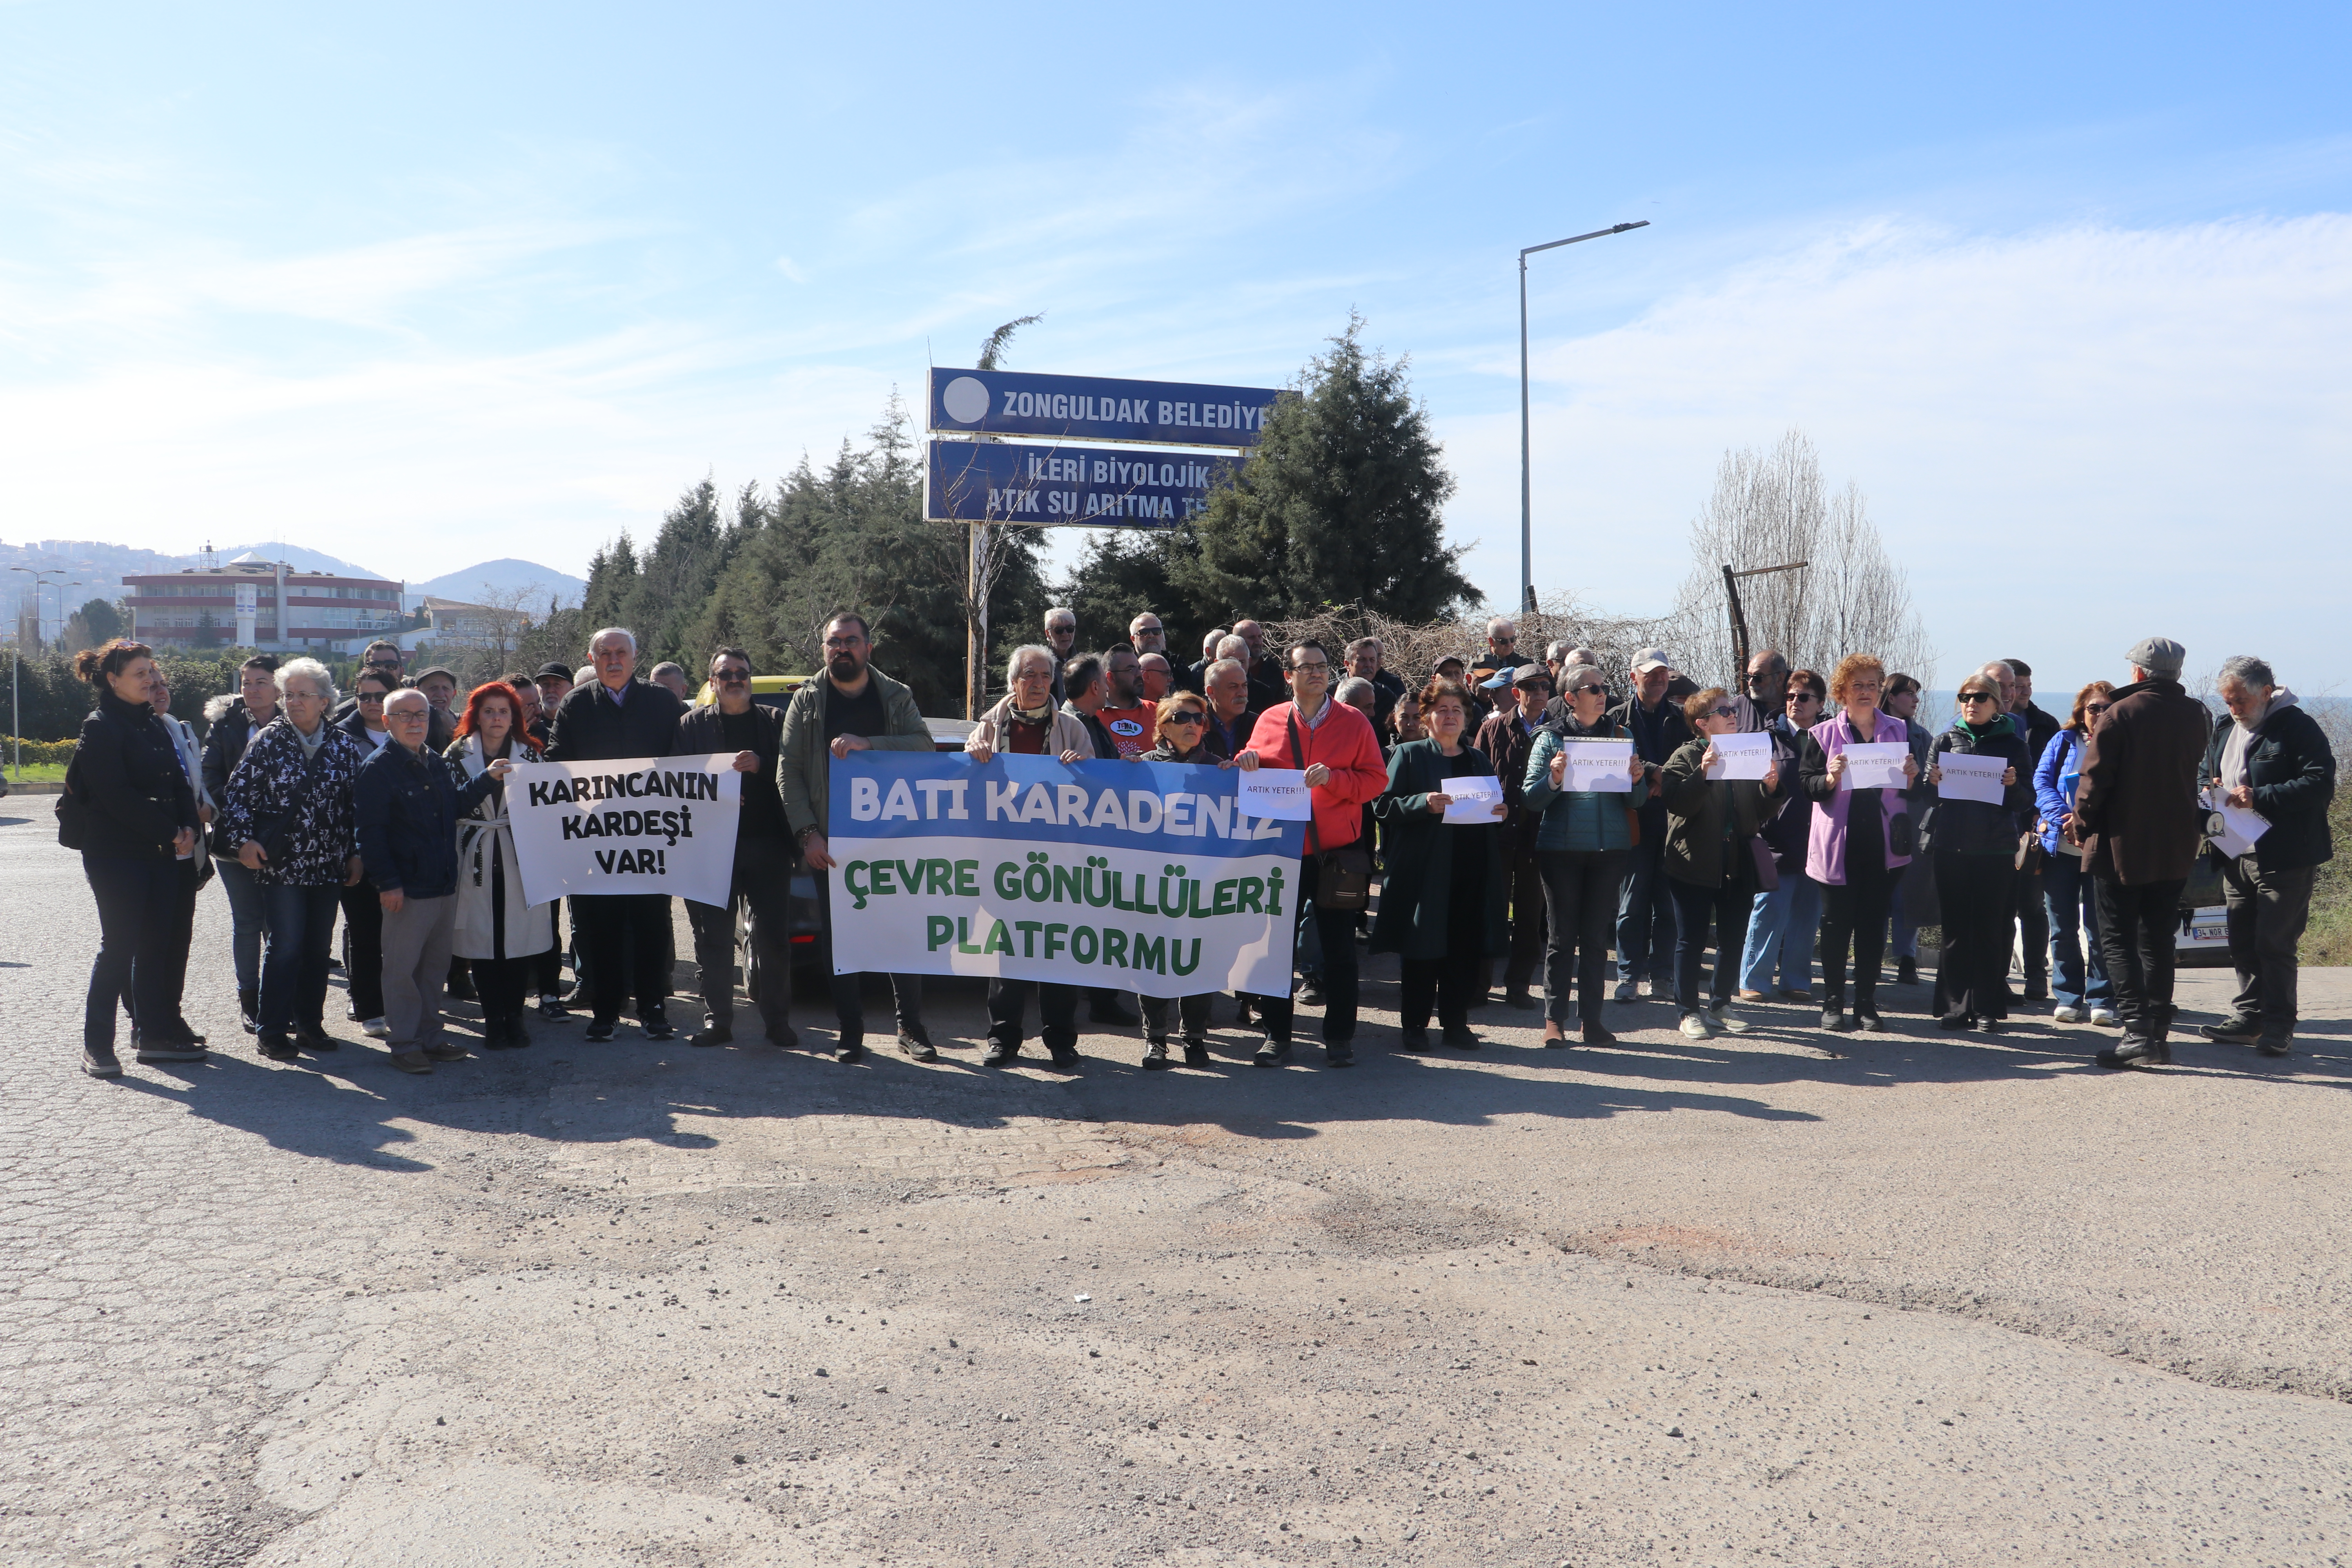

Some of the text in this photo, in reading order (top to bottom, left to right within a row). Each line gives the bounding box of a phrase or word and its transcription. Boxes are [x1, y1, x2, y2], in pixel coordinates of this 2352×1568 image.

[1003, 391, 1149, 424] ZONGULDAK
[1028, 452, 1210, 488] İLERİ BİYOLOJİK
[986, 488, 1040, 513] ATIK
[1047, 490, 1078, 515] SU
[1085, 493, 1175, 519] ARITMA
[1117, 722, 1133, 730] TEMA
[1740, 748, 1767, 757] YETER!!!
[528, 770, 718, 807] KARINCANIN
[1969, 770, 2000, 779] YETER!!!
[850, 777, 969, 821] BATI
[1450, 790, 1498, 801] ARTIK YETER!!!
[562, 805, 693, 847] KARDEŞİ
[594, 849, 666, 875] VAR!
[844, 851, 1283, 919] ÇEVRE GÖNÜLLÜLERİ
[927, 915, 1201, 976] PLATFORMU
[2209, 928, 2222, 936] NOR
